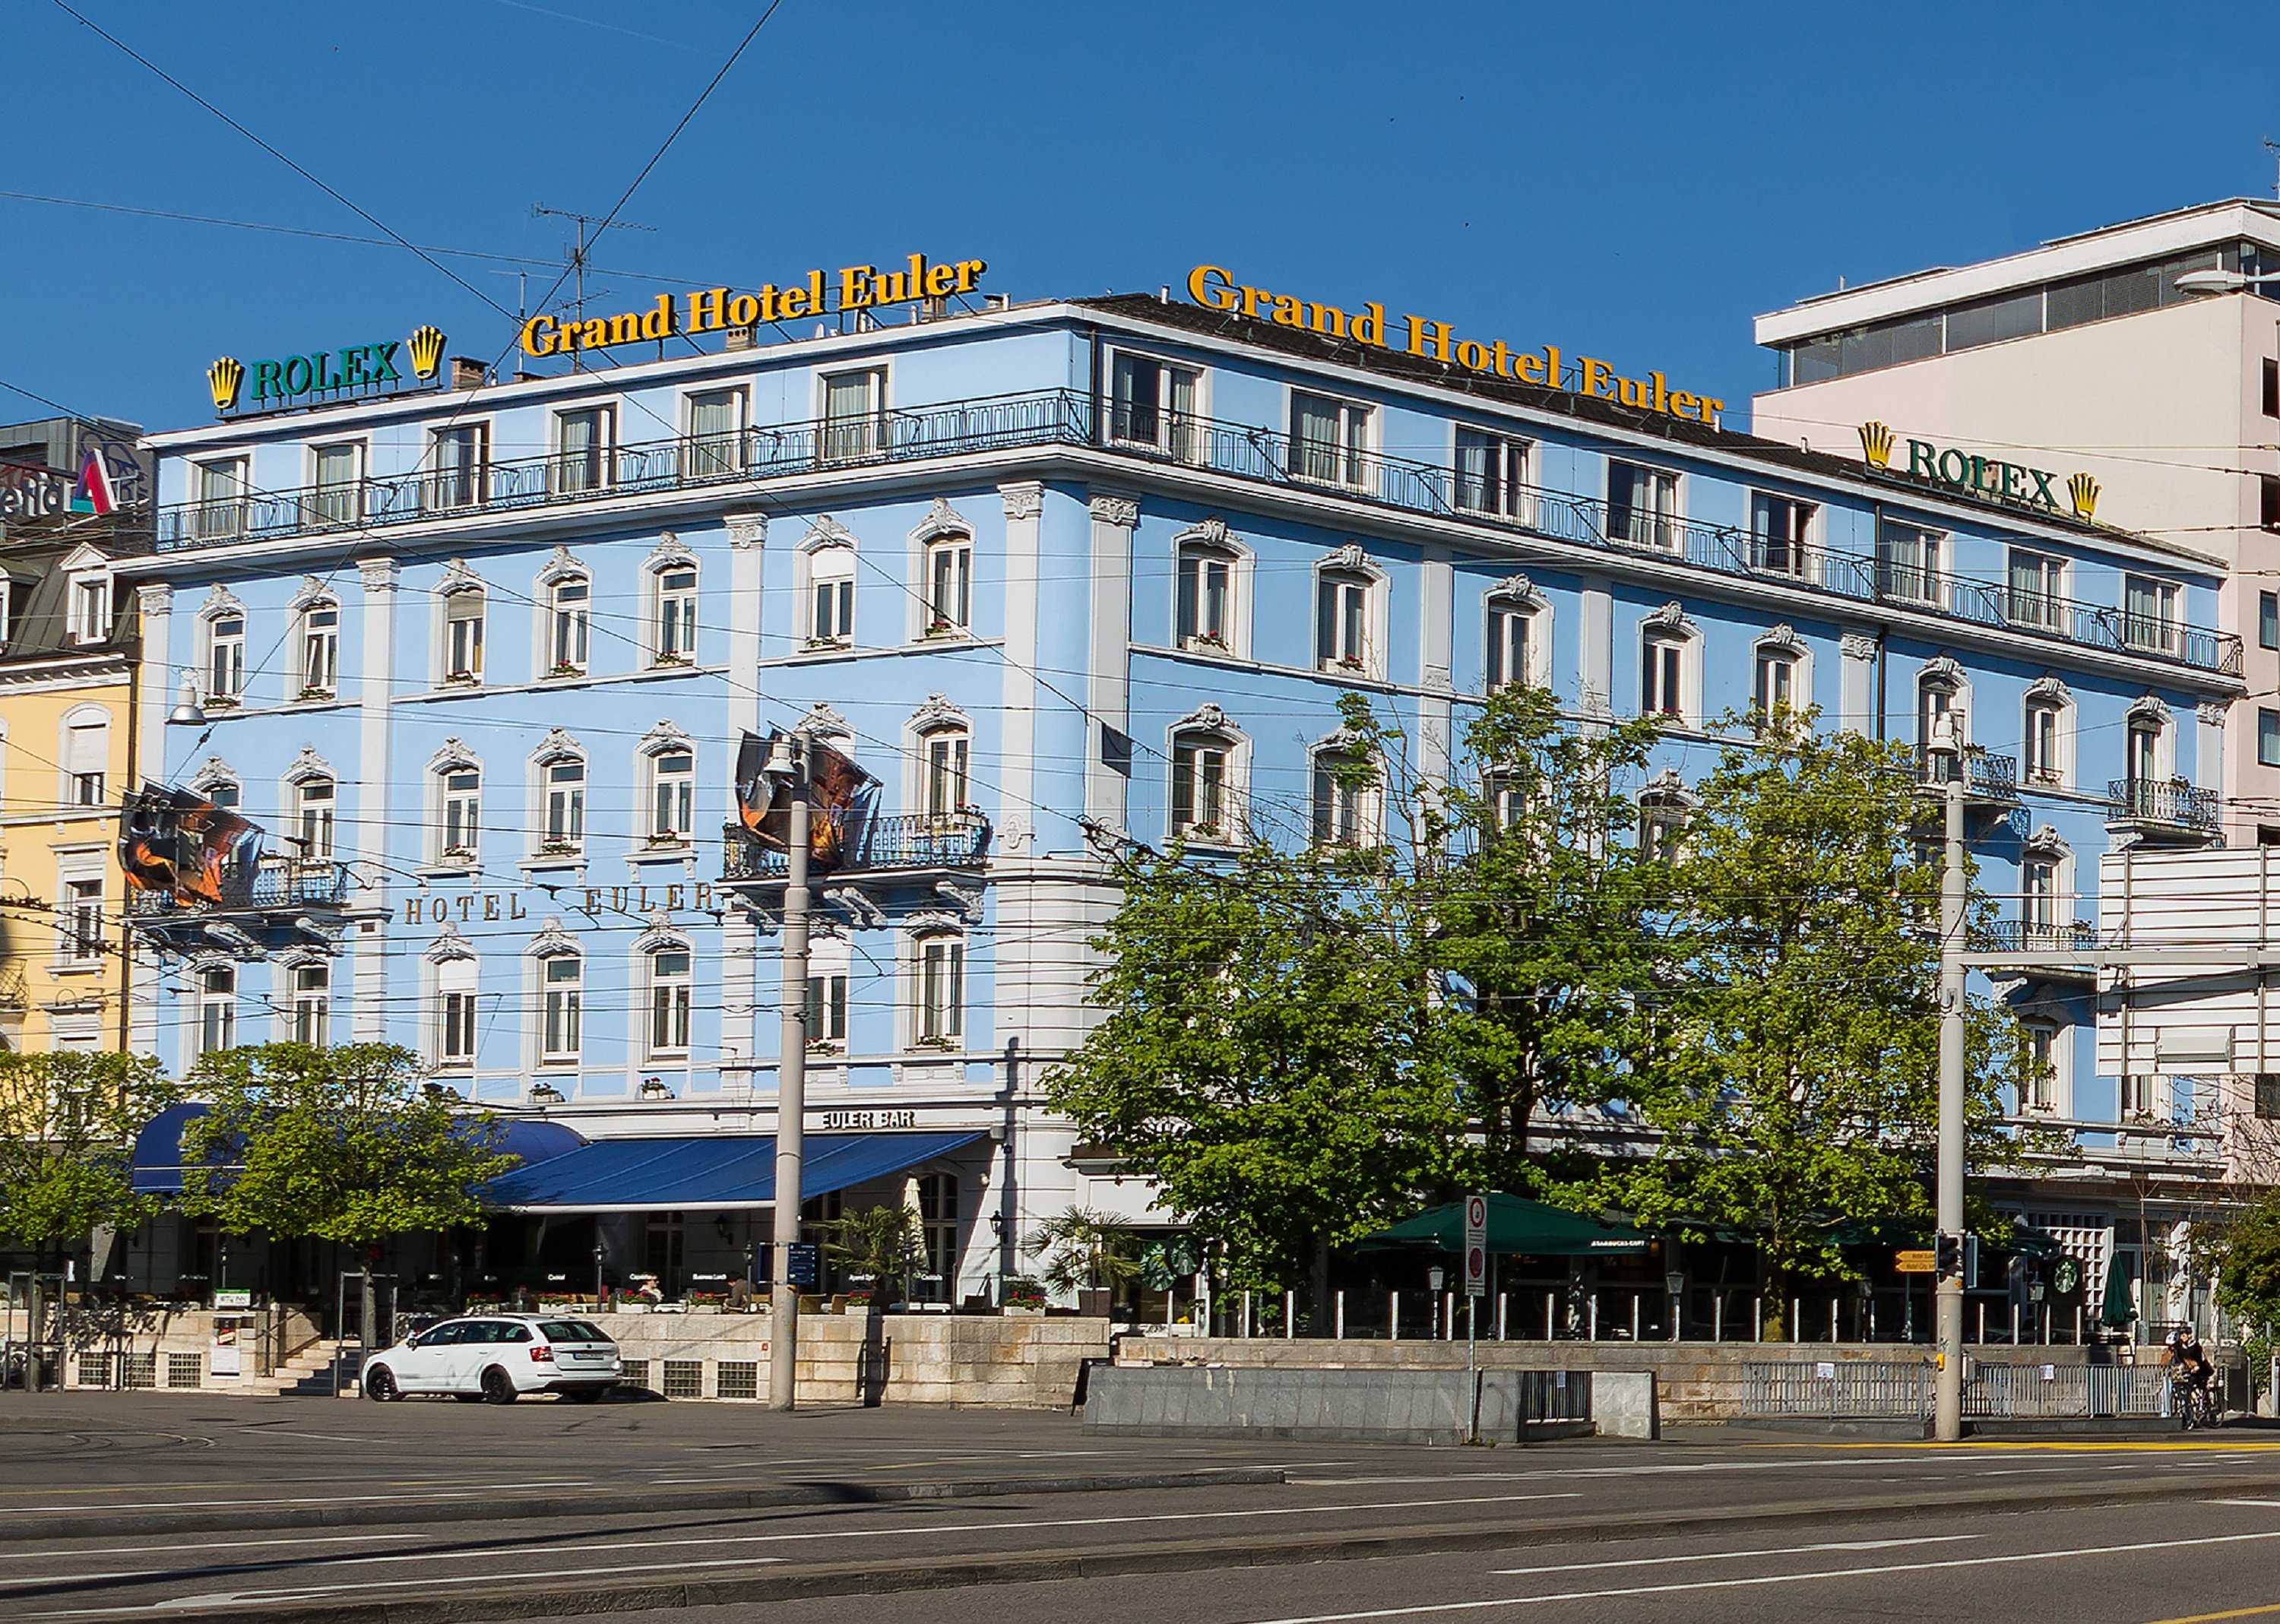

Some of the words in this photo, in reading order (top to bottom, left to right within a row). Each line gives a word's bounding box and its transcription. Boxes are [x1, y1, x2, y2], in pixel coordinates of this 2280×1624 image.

[521, 294, 675, 357] Grand
[687, 271, 825, 334] Hotel
[839, 254, 986, 310] Euler
[250, 340, 403, 400] ROLEX
[1187, 264, 1386, 348] Grand
[1404, 314, 1563, 389] Hotel
[1577, 356, 1724, 425] Euler
[1906, 438, 2060, 508] ROLEX
[404, 892, 527, 925] HOTEL
[584, 882, 714, 916] EULER
[822, 1111, 874, 1130] EULER
[880, 1110, 917, 1129] BAR
